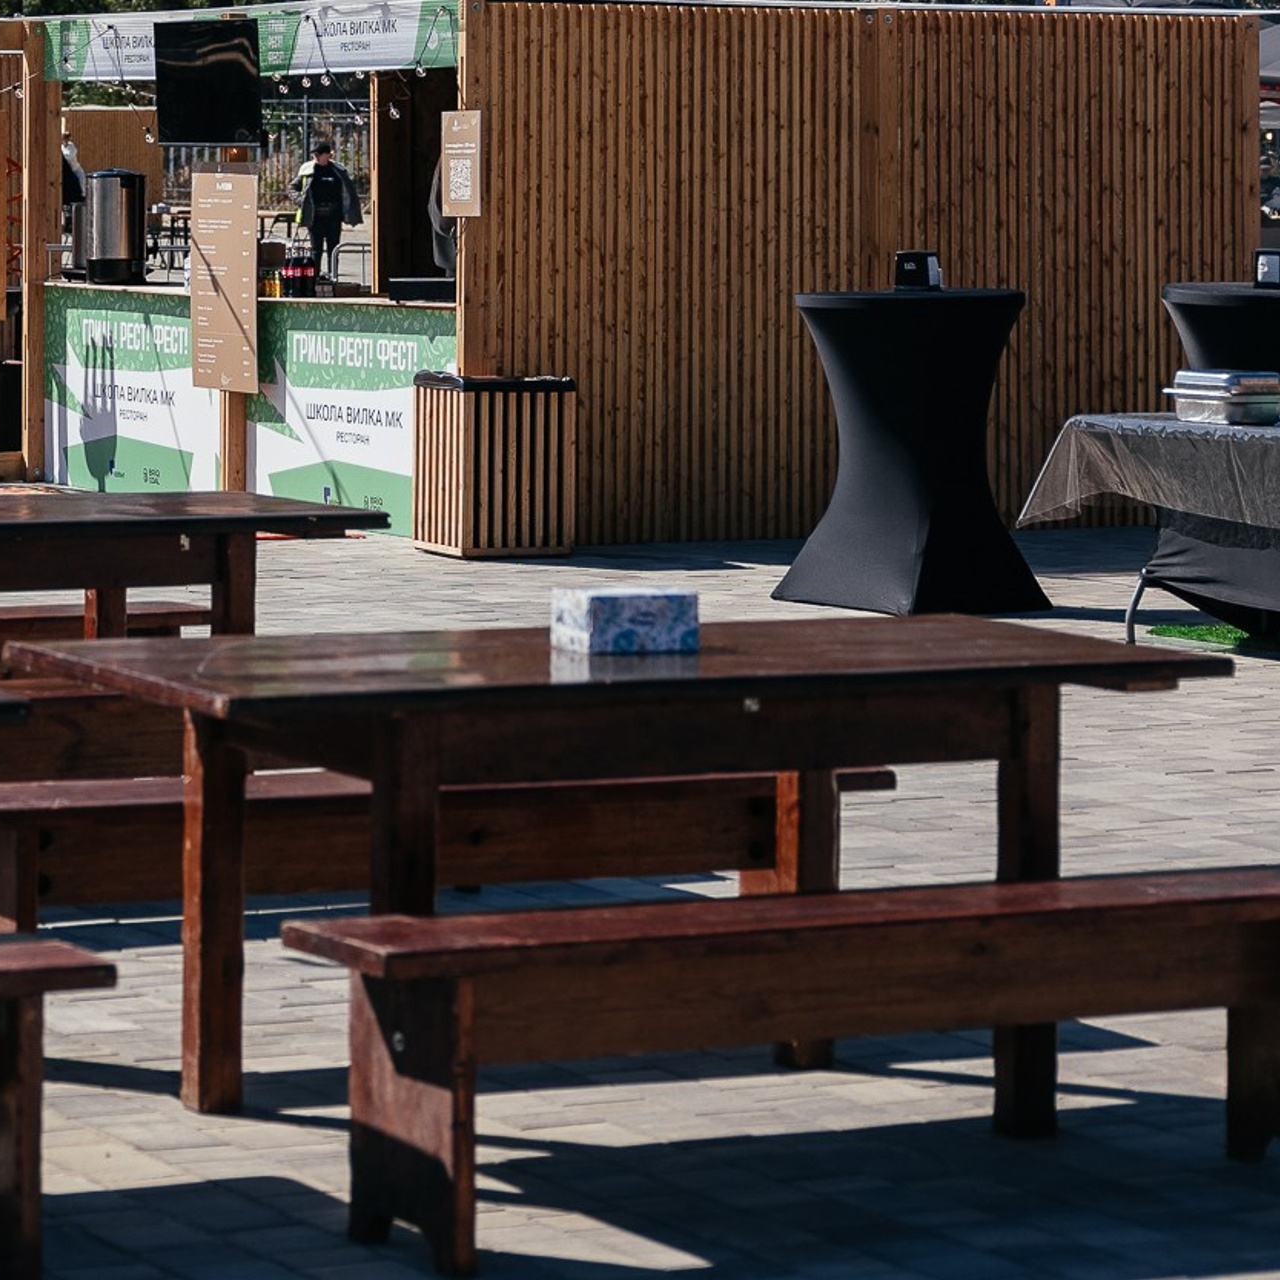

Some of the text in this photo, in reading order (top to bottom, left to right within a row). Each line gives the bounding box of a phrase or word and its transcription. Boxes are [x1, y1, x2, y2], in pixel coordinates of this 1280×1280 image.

[318, 19, 397, 37] КОЛА ВИЛКА МК
[133, 35, 155, 49] ВИЛК
[340, 40, 371, 52] РЕСТОРАН
[82, 318, 188, 354] ГРИЛЬ! РЕСТ! ФЕСТ!
[292, 334, 418, 371] ГРИЛЬ! РЕСТ! ФЕСТ!
[94, 382, 176, 407] ШКОЛА ВИЛКА МК
[119, 407, 148, 422] РЕСТОРАН
[306, 402, 403, 429] ШКОЛА ВИЛКА МК
[336, 430, 370, 445] РЕСТОРАН
